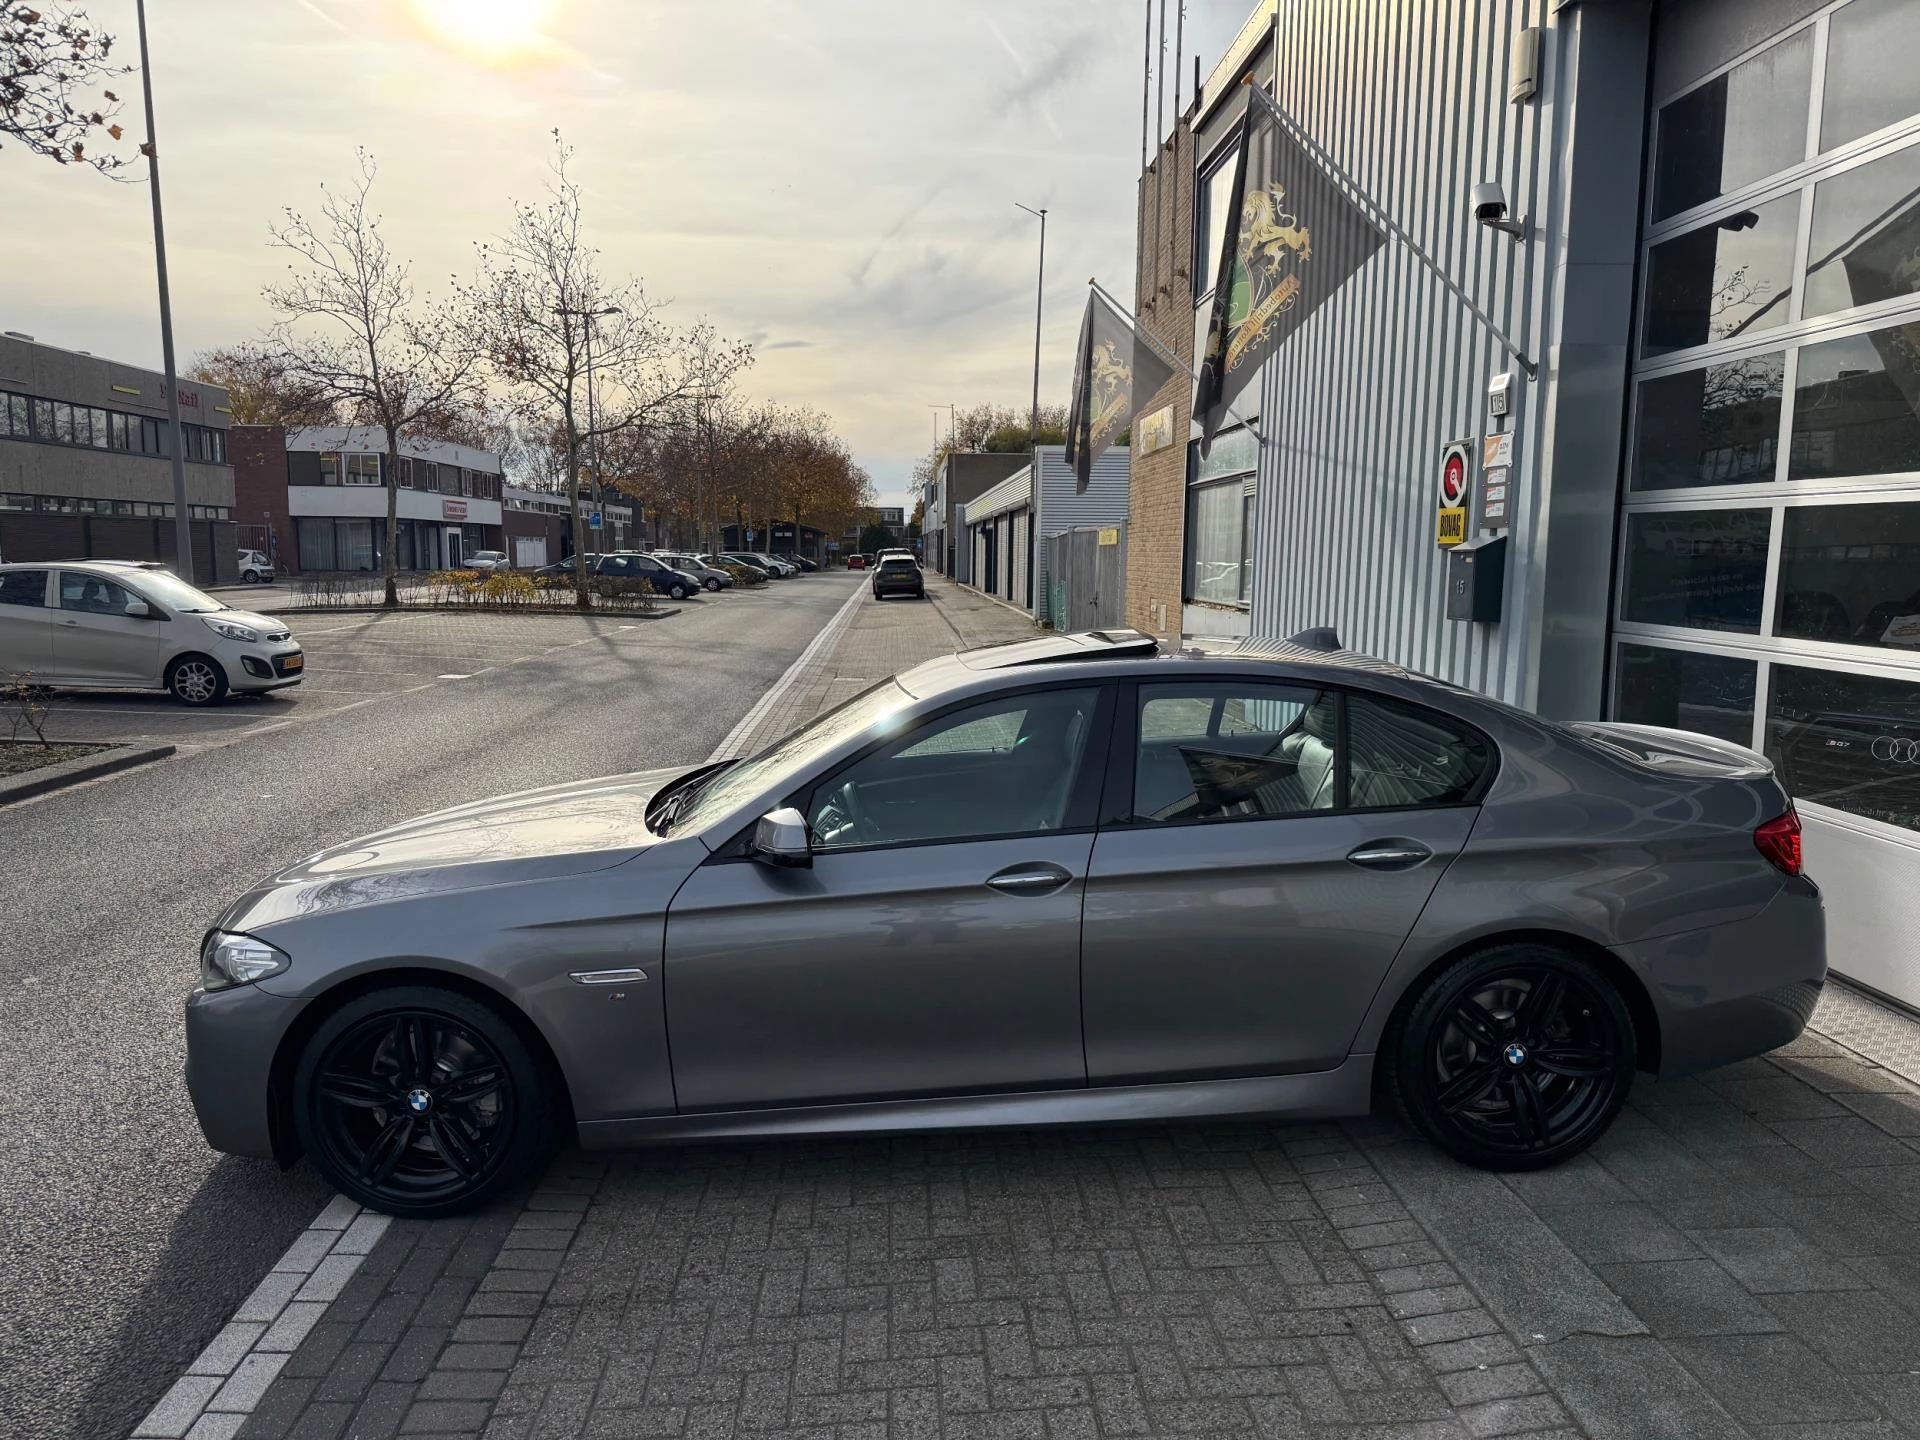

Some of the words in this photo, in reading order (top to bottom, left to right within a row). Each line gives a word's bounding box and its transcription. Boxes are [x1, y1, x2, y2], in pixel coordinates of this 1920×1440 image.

[1493, 395, 1504, 411] 15
[1440, 513, 1461, 537] BOVAG
[1456, 580, 1464, 594] 15
